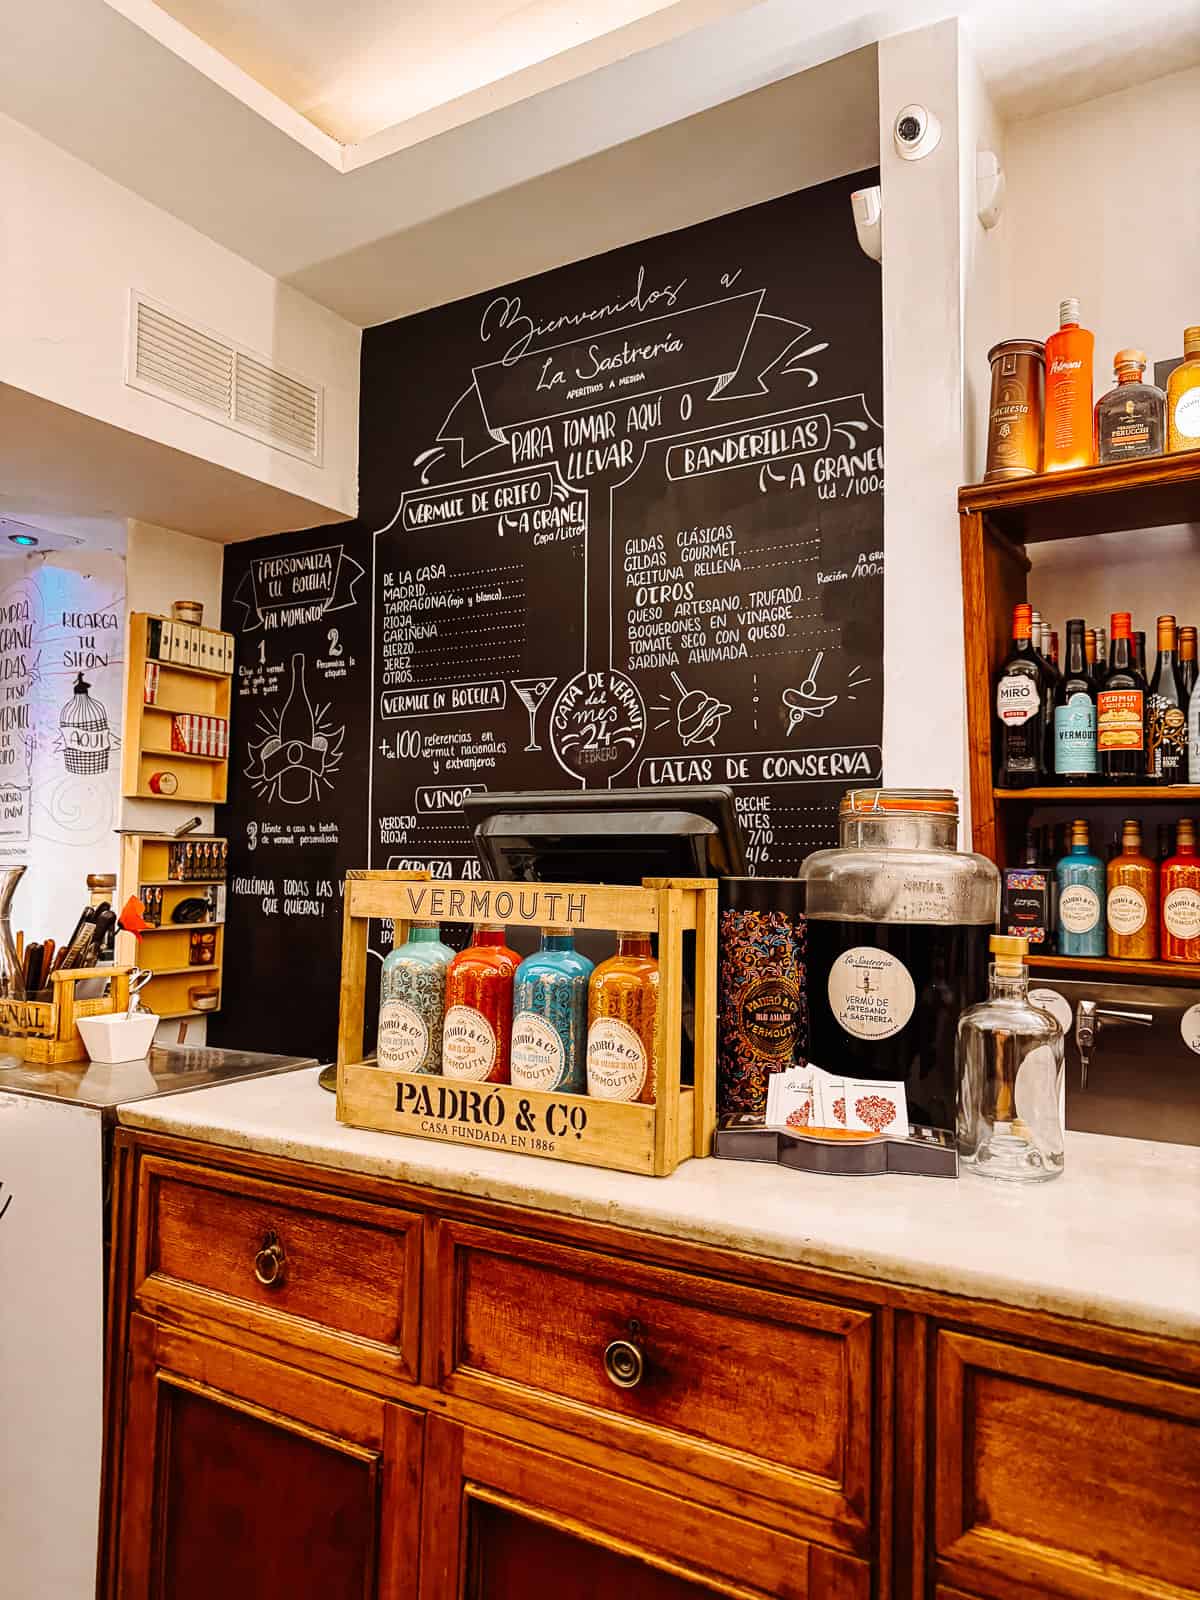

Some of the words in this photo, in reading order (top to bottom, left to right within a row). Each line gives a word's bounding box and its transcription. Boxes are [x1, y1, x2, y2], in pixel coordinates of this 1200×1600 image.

[480, 265, 687, 366] Bienvenidos
[535, 359, 567, 392] La
[576, 333, 683, 380] Sastrería
[566, 383, 605, 399] APERITIVOS
[609, 380, 616, 388] A
[619, 373, 646, 387] MEDIDA
[512, 424, 553, 463] PARA
[564, 412, 616, 448] TOMAR
[627, 400, 663, 432] AQUÍ
[680, 394, 692, 421] O
[567, 441, 634, 481] LLEVAR
[684, 421, 819, 475] BANDERILLAS
[791, 463, 806, 489] A
[813, 446, 884, 484] GRANEL
[408, 499, 464, 525] VERMUT
[471, 493, 488, 513] DE
[494, 481, 541, 508] GRIFO
[518, 513, 529, 533] A
[533, 501, 585, 531] GRANEL
[625, 535, 664, 556] GILDAS
[677, 524, 734, 547] CLÁSICAS
[624, 552, 667, 572] GILDAS
[681, 541, 737, 562] GOURMET
[383, 573, 394, 586] DE
[400, 571, 412, 584] LA
[416, 564, 446, 581] CASA
[626, 566, 684, 587] ACEITUNA
[694, 558, 742, 577] RELLENA
[268, 580, 283, 597] TU
[383, 584, 426, 601] MADRID
[467, 596, 473, 607] y
[635, 582, 695, 607] OTROS
[627, 608, 663, 624] QUESO
[674, 596, 740, 617] ARTESANO
[749, 586, 802, 609] TRUFADO
[62, 611, 119, 630] RECARGA
[383, 615, 412, 630] RIOJA
[383, 624, 438, 643] CARIÑENA
[628, 621, 701, 641] BOQUERONES
[710, 615, 727, 630] EN
[737, 605, 793, 625] VINAGRE
[79, 635, 95, 649] TU
[327, 628, 344, 657] 2
[383, 642, 414, 657] BIERZO
[629, 637, 673, 655] TOMATE
[680, 633, 706, 649] SECO
[715, 629, 740, 645] CON
[747, 623, 786, 642] QUESO
[257, 640, 266, 665] 1
[384, 656, 411, 671] JEREZ
[628, 653, 680, 670] SARDINA
[688, 643, 749, 664] AHUMADA
[383, 670, 413, 685] OTROS
[383, 695, 430, 714] VERMUT
[433, 692, 446, 710] EN
[451, 686, 500, 708] BOTELLA
[555, 685, 583, 730] CATA
[588, 672, 605, 690] DE
[609, 676, 643, 730] VERMUT
[573, 706, 618, 725] mes
[424, 730, 472, 746] referencias
[481, 731, 494, 742] en
[461, 742, 508, 756] nacionales
[432, 761, 440, 775] y
[445, 757, 496, 771] extranjeros
[649, 759, 713, 785] LATAS
[726, 758, 750, 780] DE
[762, 751, 872, 780] CONSERVA
[378, 815, 417, 830] VERDEJO
[246, 821, 257, 851] 3
[380, 830, 408, 845] RIOJA
[461, 860, 482, 880] AR
[283, 879, 309, 897] TODAS
[316, 880, 333, 897] LAS
[262, 897, 279, 917] QUE
[406, 887, 588, 924] VERMOUTH
[876, 998, 889, 1008] DE
[394, 1081, 506, 1128] PADRÓ
[514, 1098, 536, 1133] &
[420, 1120, 450, 1137] CASA
[451, 1124, 507, 1145] FUNDADA
[511, 1136, 527, 1149] EN
[530, 1137, 556, 1152] 1886
